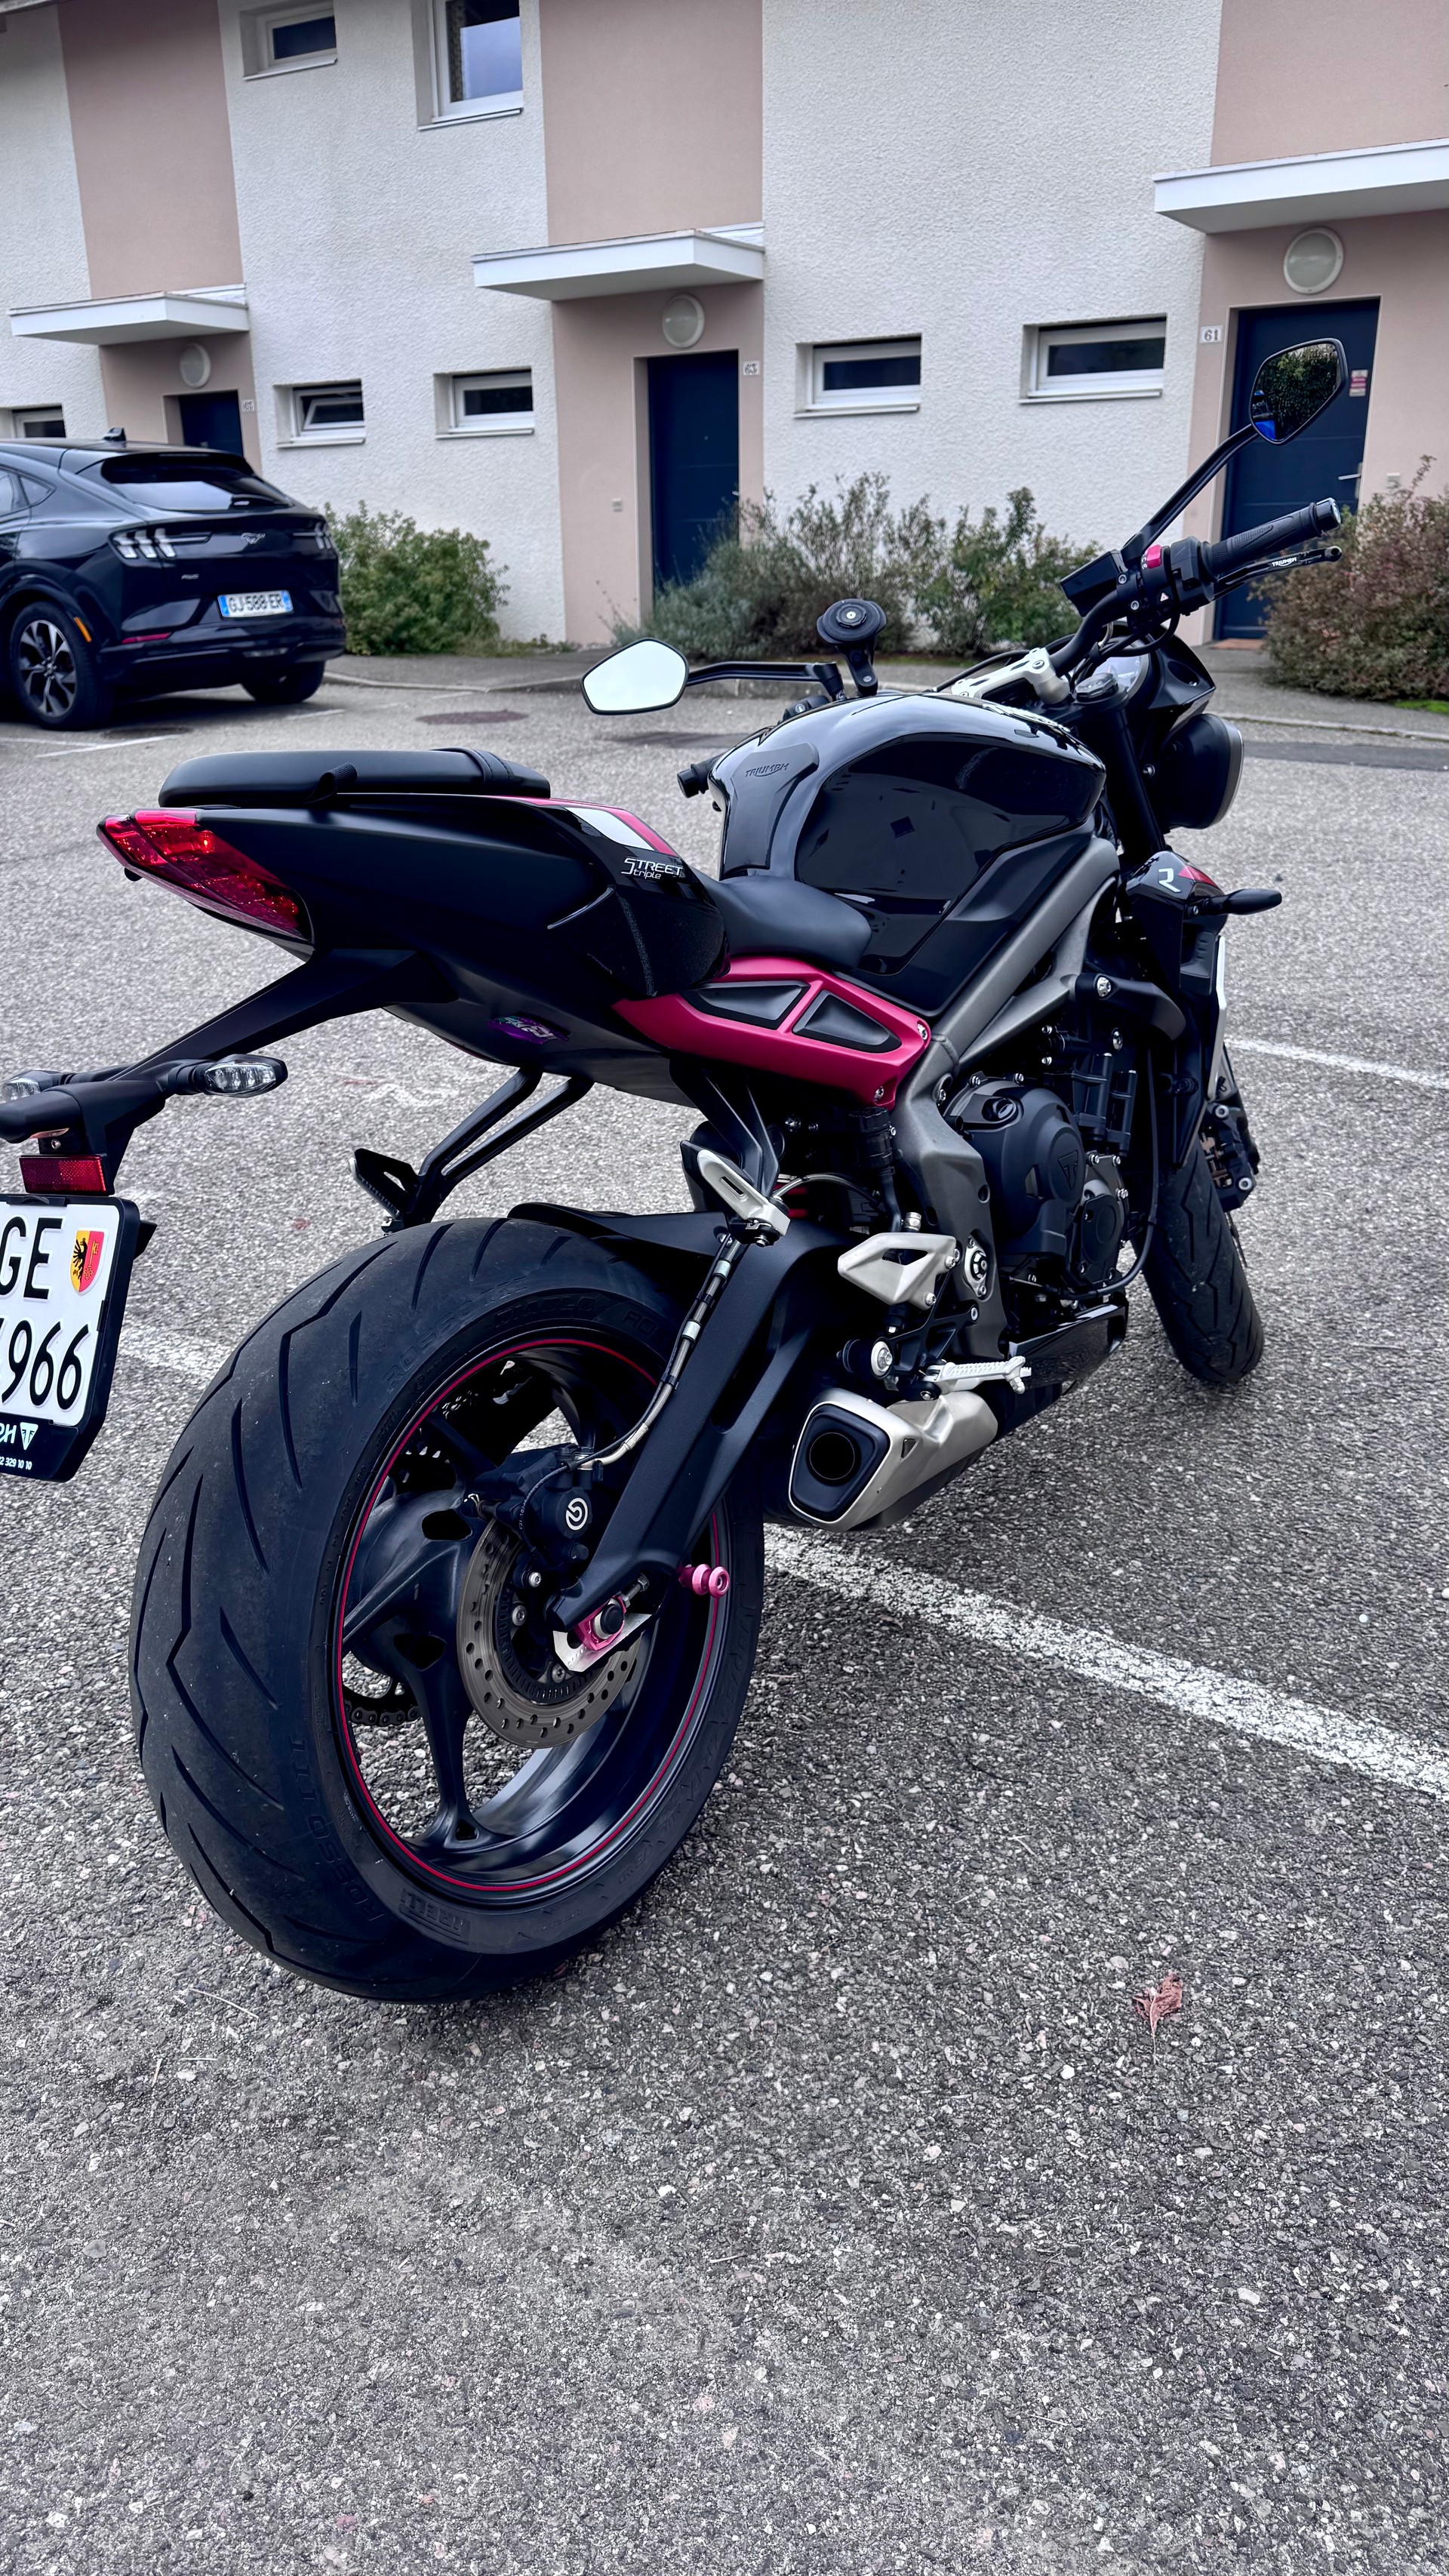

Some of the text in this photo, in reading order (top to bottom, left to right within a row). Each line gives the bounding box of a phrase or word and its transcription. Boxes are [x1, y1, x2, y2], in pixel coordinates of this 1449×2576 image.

[1204, 329, 1219, 341] 61
[1272, 557, 1297, 567] TRIUMPH
[745, 762, 789, 777] TRIUMPH
[620, 857, 683, 876] STREET
[1158, 868, 1181, 893] R
[0, 1216, 63, 1299] GE
[380, 1298, 474, 1394] ROSSO
[0, 1317, 90, 1410] 966
[5, 1457, 17, 1467] 329
[17, 1459, 25, 1469] 10
[25, 1460, 32, 1470] 10
[306, 1813, 386, 1922] ROSSO
[398, 1887, 471, 1945] PIRELLI
